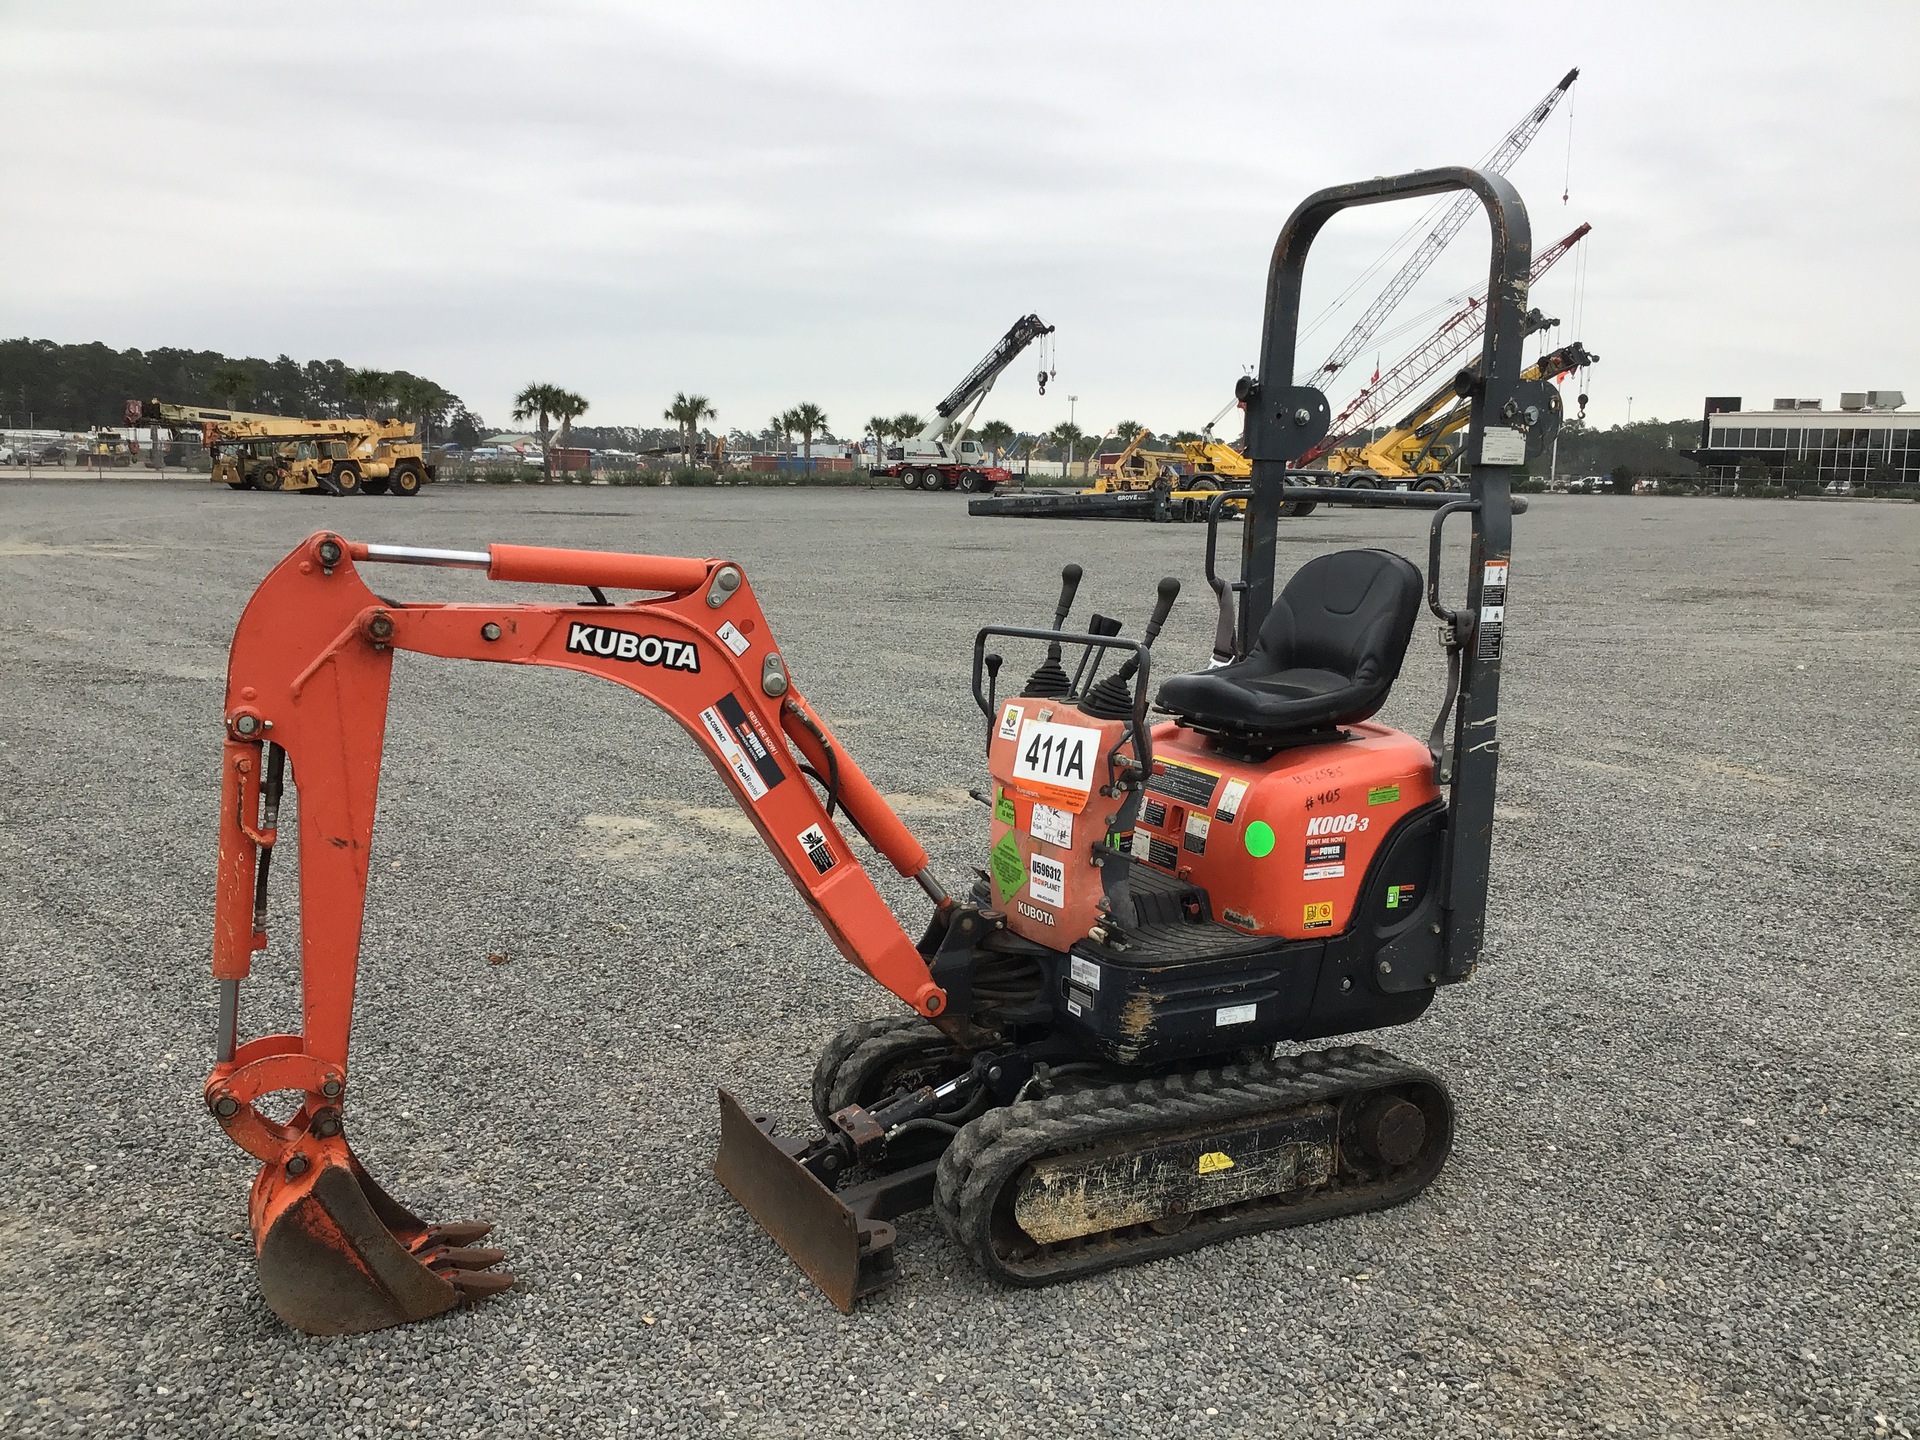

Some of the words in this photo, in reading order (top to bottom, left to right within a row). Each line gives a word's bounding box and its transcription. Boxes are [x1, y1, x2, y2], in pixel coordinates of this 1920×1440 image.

[569, 624, 698, 670] KUBOTA
[746, 709, 761, 728] RENT
[757, 726, 767, 738] ME
[745, 731, 767, 759] POWER
[1025, 733, 1084, 781] 411A
[1306, 813, 1370, 836] K008-3
[1320, 846, 1340, 856] POWER
[1032, 860, 1061, 882] U596312
[1017, 900, 1056, 927] KUBOTA
